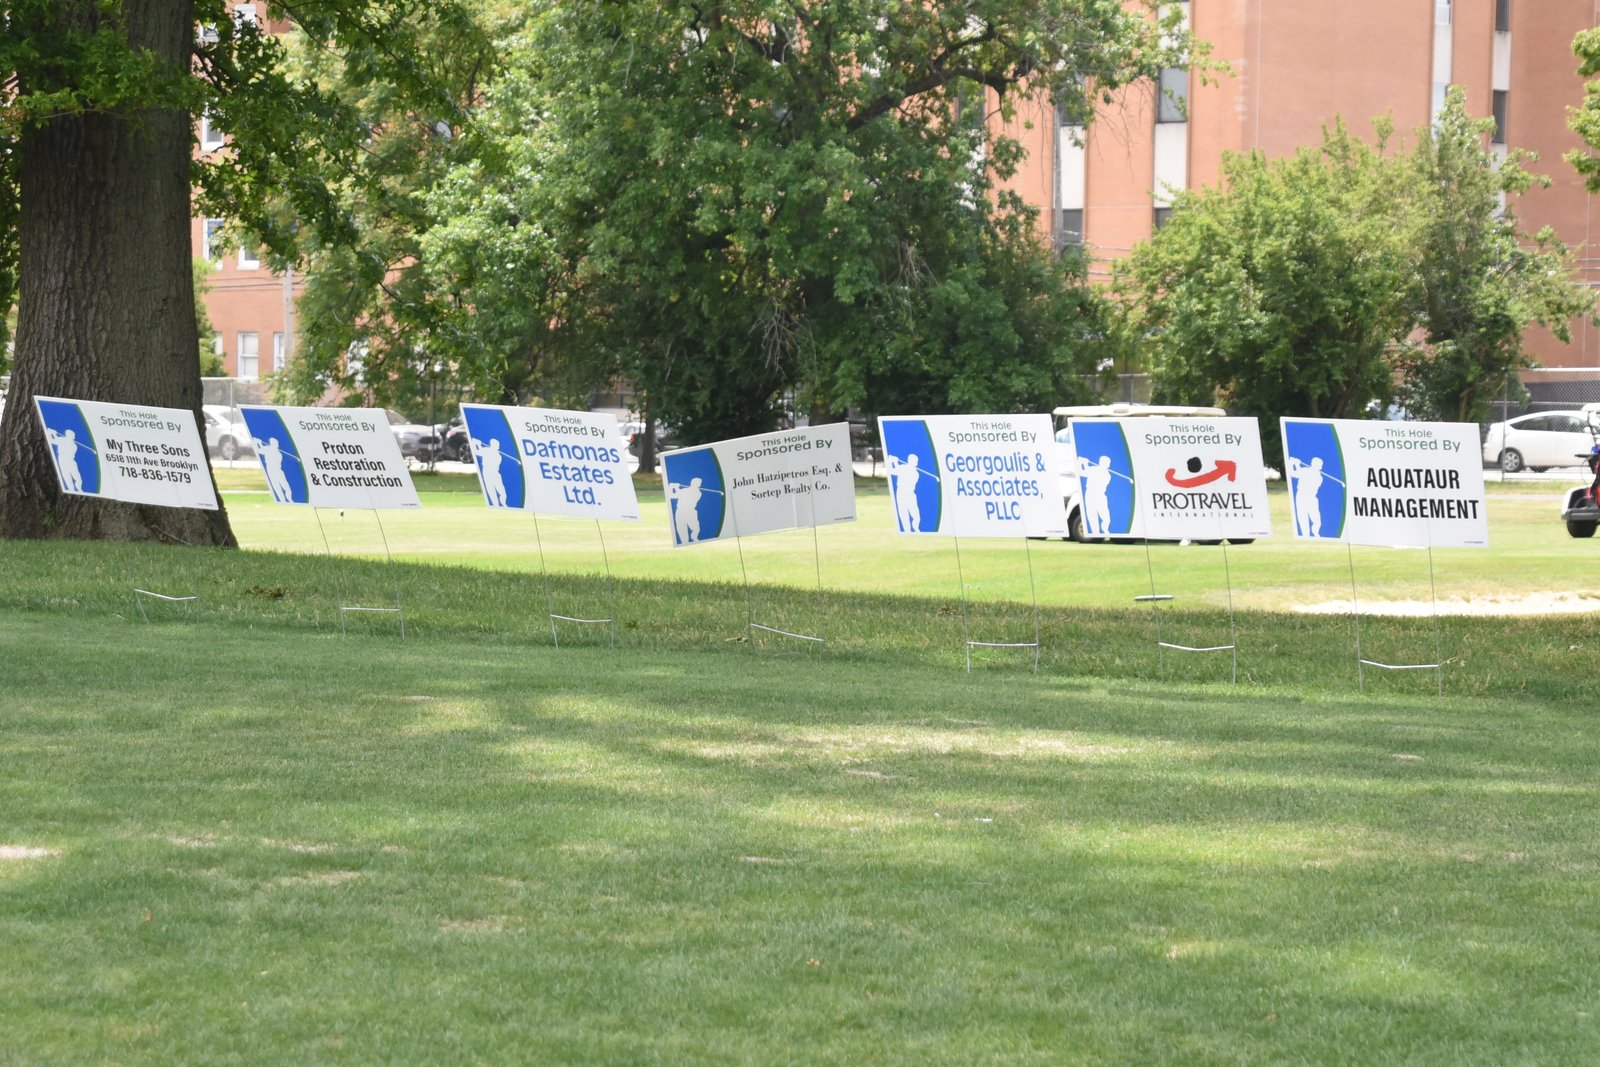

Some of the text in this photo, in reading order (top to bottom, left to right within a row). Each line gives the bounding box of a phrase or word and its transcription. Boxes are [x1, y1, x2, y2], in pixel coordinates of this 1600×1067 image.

[101, 416, 181, 432] Sponsored By
[140, 412, 158, 420] Hole
[544, 415, 582, 425] This Hole
[299, 421, 375, 432] Sponsored By
[525, 422, 605, 438] Sponsored By
[992, 422, 1011, 430] Hole
[1385, 429, 1432, 438] This Hole
[761, 435, 806, 447] This Hole
[949, 431, 1036, 443] Sponsored By
[1145, 434, 1241, 446] Sponsored By
[1359, 438, 1460, 452] Sponsored By
[106, 439, 190, 457] My Three Sons
[322, 442, 364, 454] Proton
[522, 439, 620, 463] Dafnonas
[737, 440, 832, 461] Sponsored By
[106, 454, 124, 463] 6518
[144, 458, 158, 466] Ave
[160, 459, 198, 471] Brooklyn
[314, 458, 385, 471] Restoration
[946, 452, 1046, 475] Georgoulis &
[119, 466, 191, 483] 718-836-1579
[311, 473, 402, 487] & Construction
[539, 462, 614, 484] Estates
[733, 478, 754, 489] John
[812, 466, 831, 475] Esq.
[835, 463, 842, 472] &
[1367, 468, 1460, 489] AQUATAUR
[564, 486, 601, 505] Ltd.
[751, 481, 830, 500] Sortep Realty Co.
[957, 476, 1043, 499] Associates,
[1153, 493, 1252, 509] PROTRAVEL
[1354, 497, 1479, 519] MANAGEMENT
[985, 501, 1021, 520] PLLC
